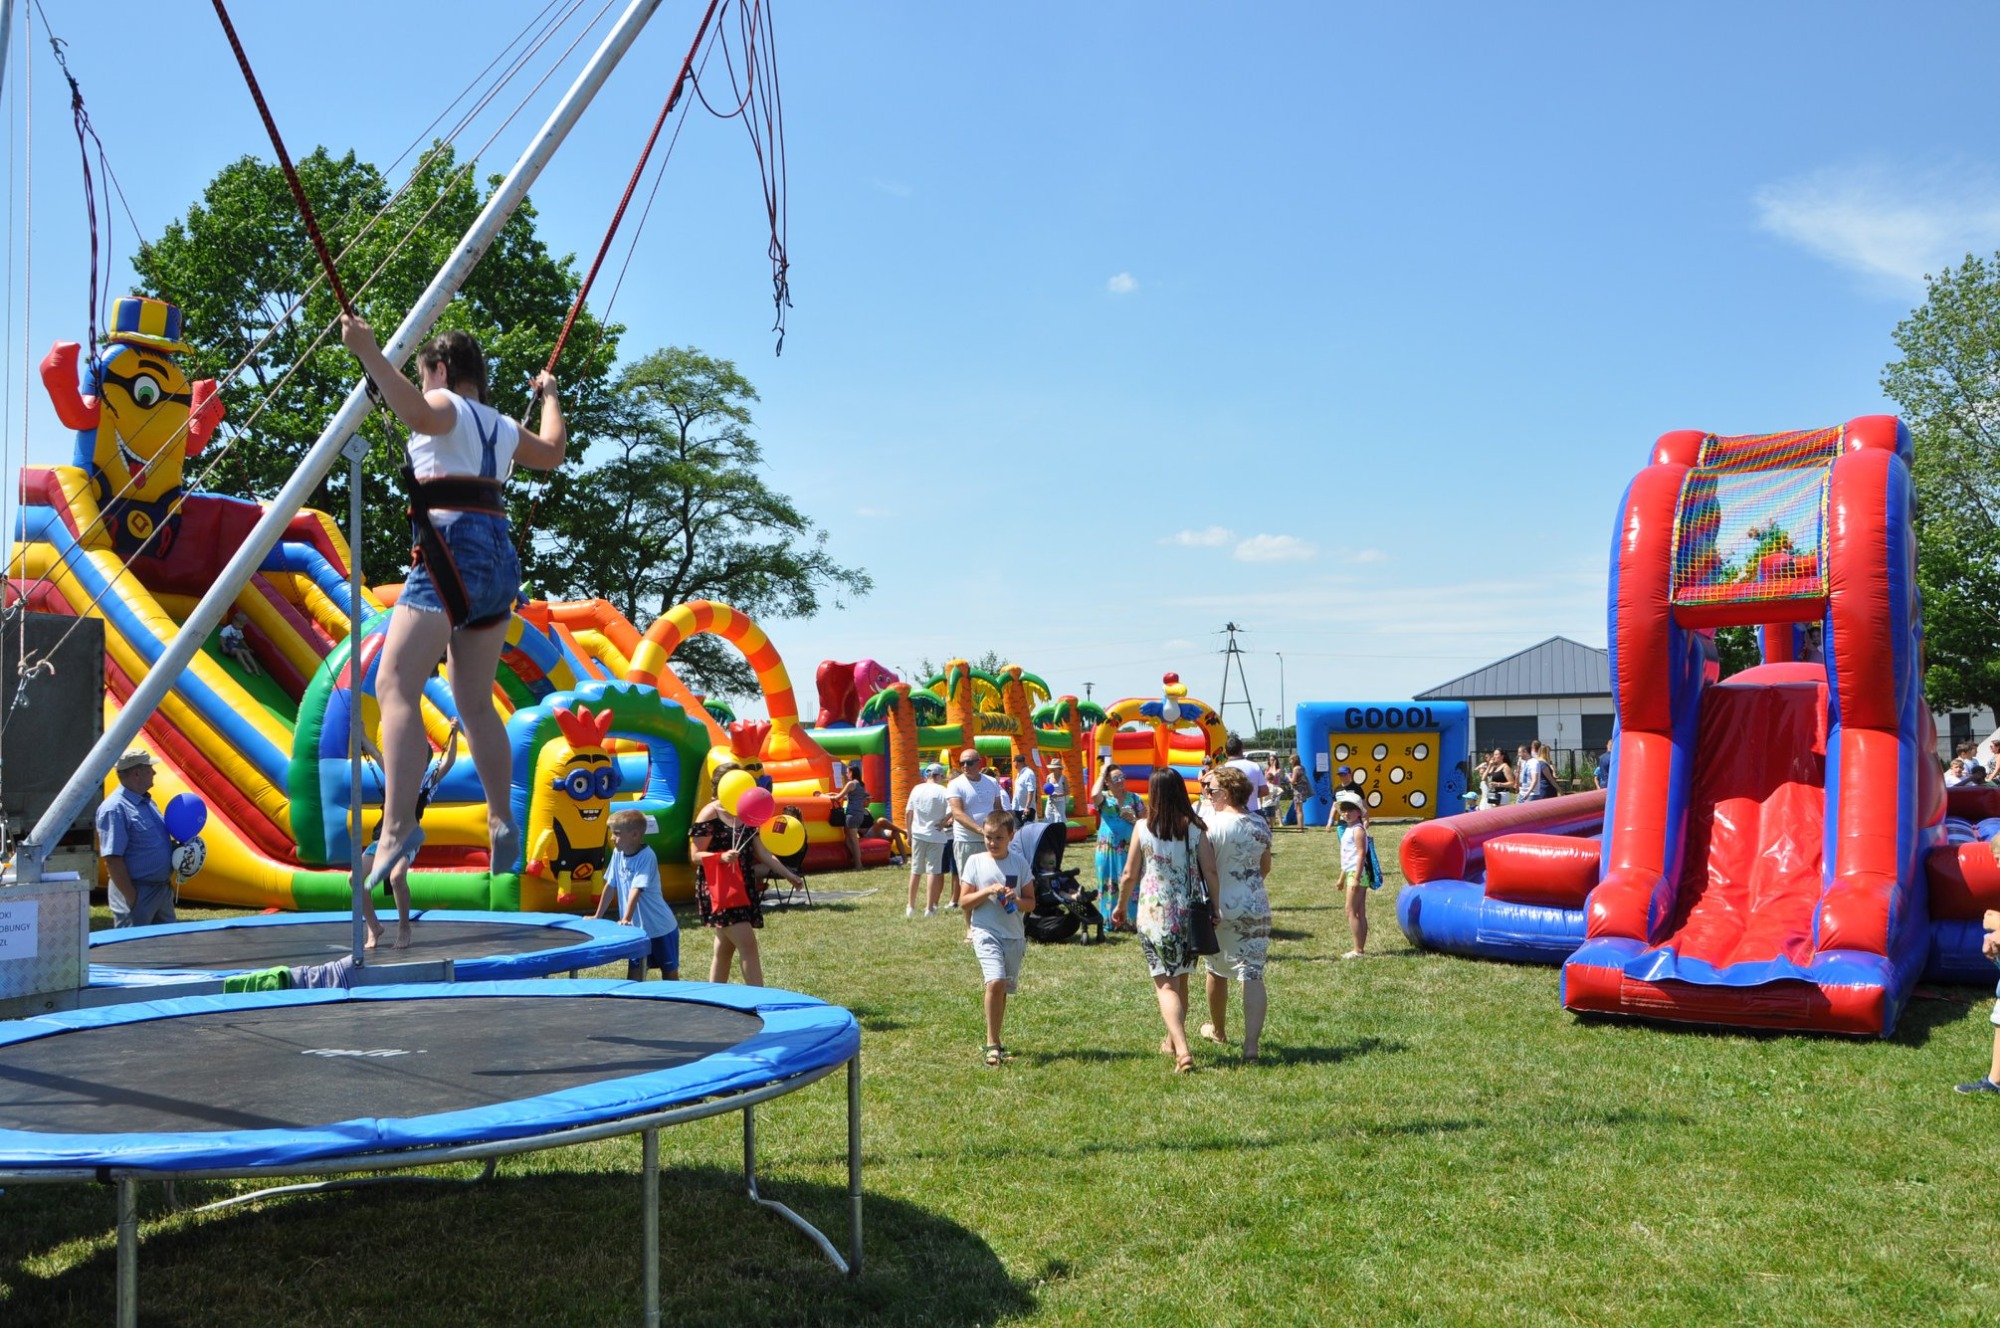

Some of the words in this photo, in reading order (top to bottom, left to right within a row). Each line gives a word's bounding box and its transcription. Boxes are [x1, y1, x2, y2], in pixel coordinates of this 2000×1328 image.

[1345, 707, 1440, 729] GOOOL
[1350, 746, 1358, 756] 5
[1405, 747, 1412, 756] 5
[1374, 764, 1381, 774] 4
[1406, 771, 1413, 780] 3
[1373, 779, 1380, 789] 2
[1401, 795, 1407, 804] 1
